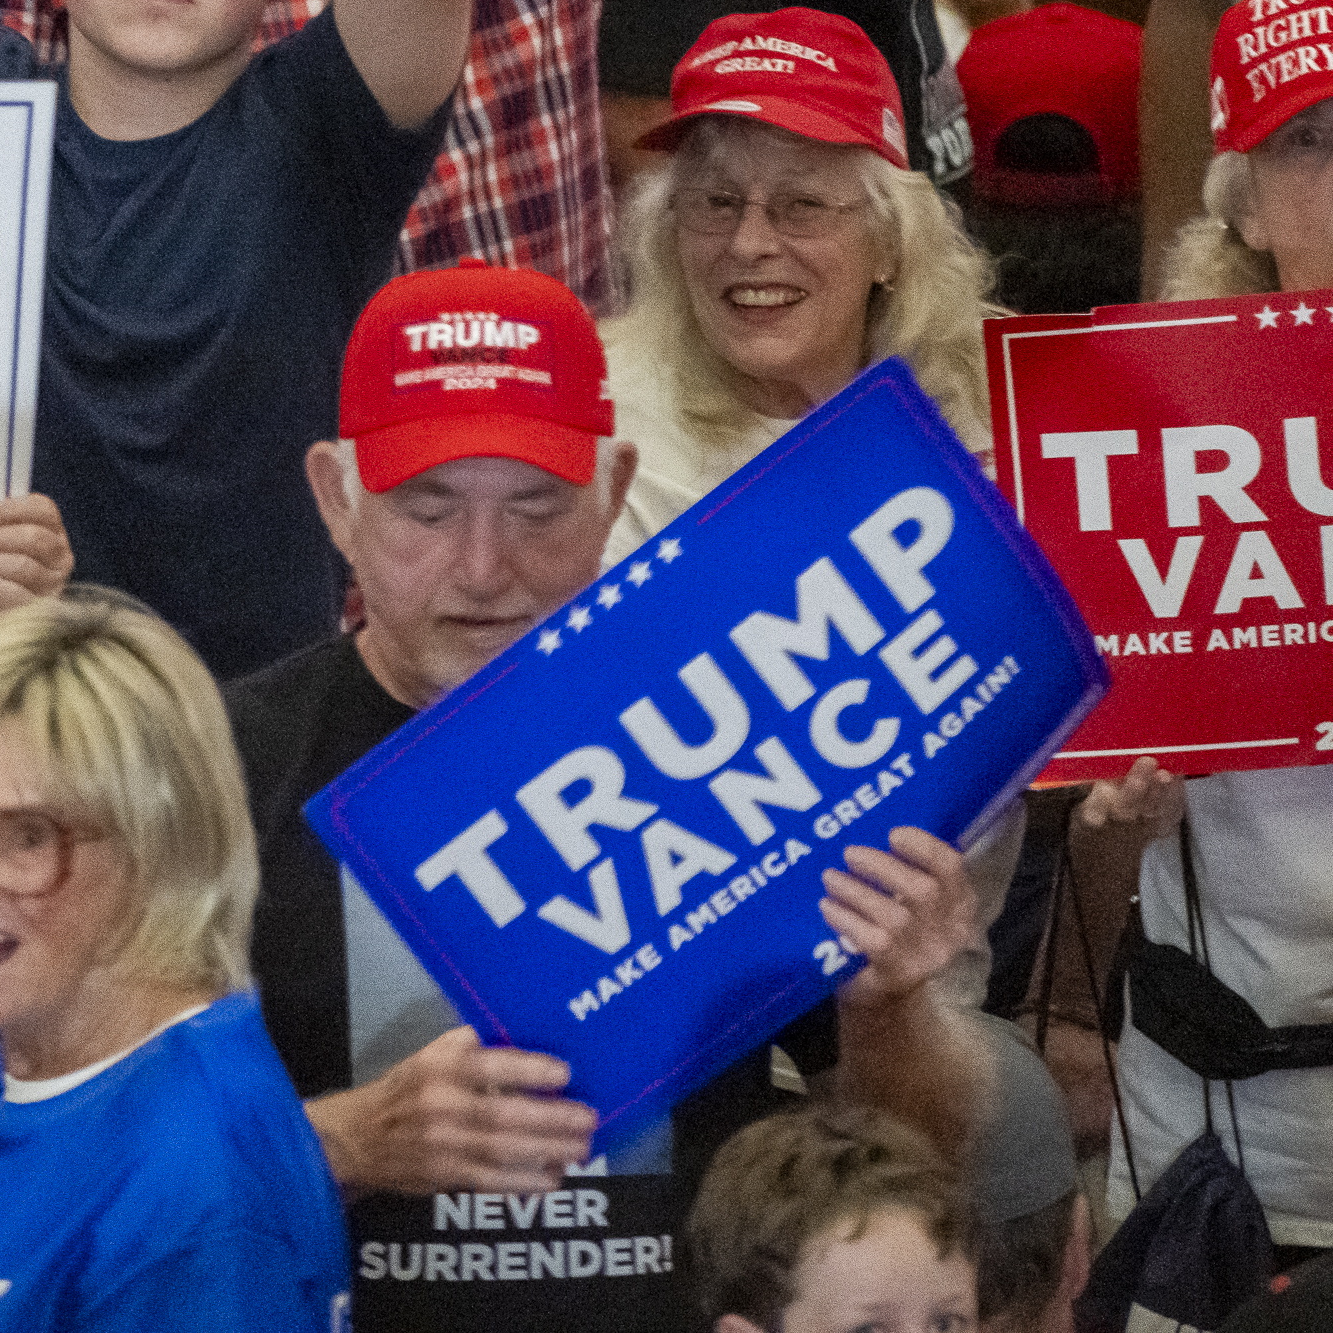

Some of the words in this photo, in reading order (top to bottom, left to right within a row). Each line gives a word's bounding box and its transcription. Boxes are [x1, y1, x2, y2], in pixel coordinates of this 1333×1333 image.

[738, 35, 838, 73] AMERICA
[1235, 6, 1333, 64] RIGHT
[714, 57, 796, 74] GREAT!
[1245, 43, 1333, 103] EVERY
[404, 320, 541, 352] TRUMP
[1039, 416, 1333, 532] TRU
[1094, 631, 1193, 656] MAKE
[1206, 619, 1333, 652] AMERIC
[415, 486, 957, 928] TRUMP
[538, 608, 979, 956] VANCE
[567, 948, 662, 1022] MAKE
[667, 839, 811, 951] AMERICA
[814, 754, 917, 840] GREAT
[923, 654, 1021, 758] AGAIN!
[433, 1189, 609, 1230] NEVER
[360, 1234, 674, 1282] SURRENDER!
